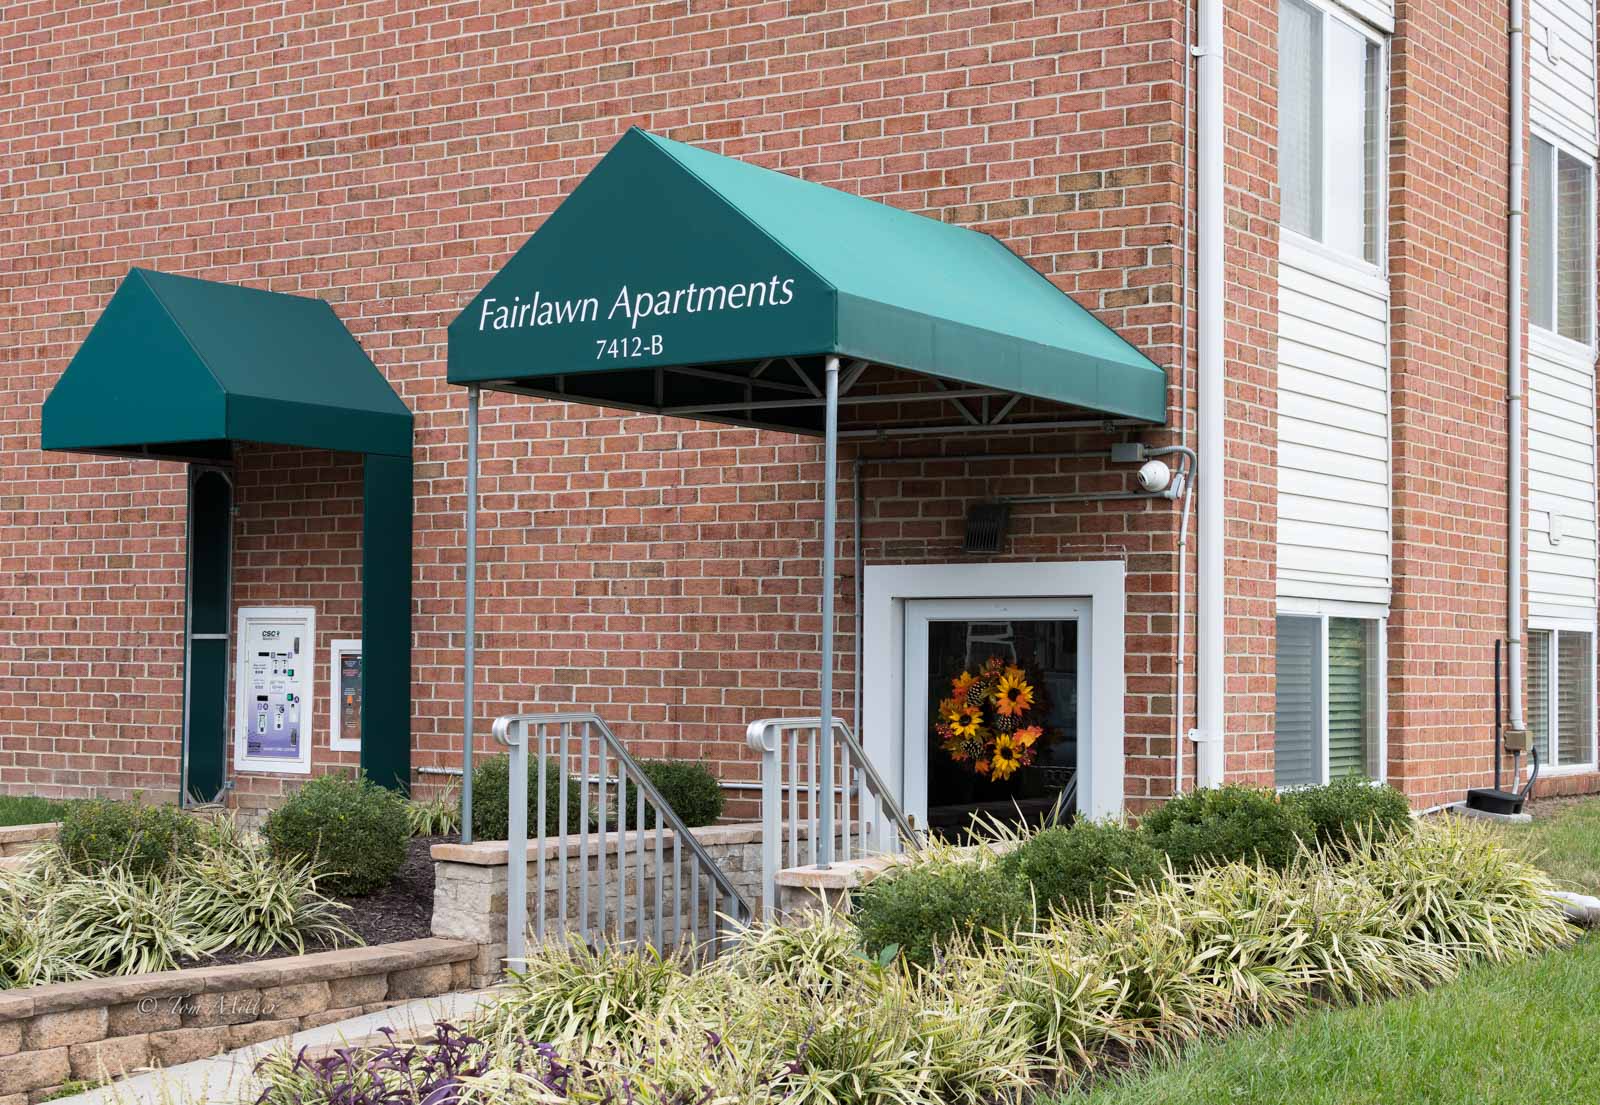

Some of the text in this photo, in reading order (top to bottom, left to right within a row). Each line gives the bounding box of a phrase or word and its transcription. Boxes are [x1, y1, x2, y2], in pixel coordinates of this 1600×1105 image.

[479, 275, 795, 331] Fairlawn Apartments
[596, 335, 664, 360] 7412-B
